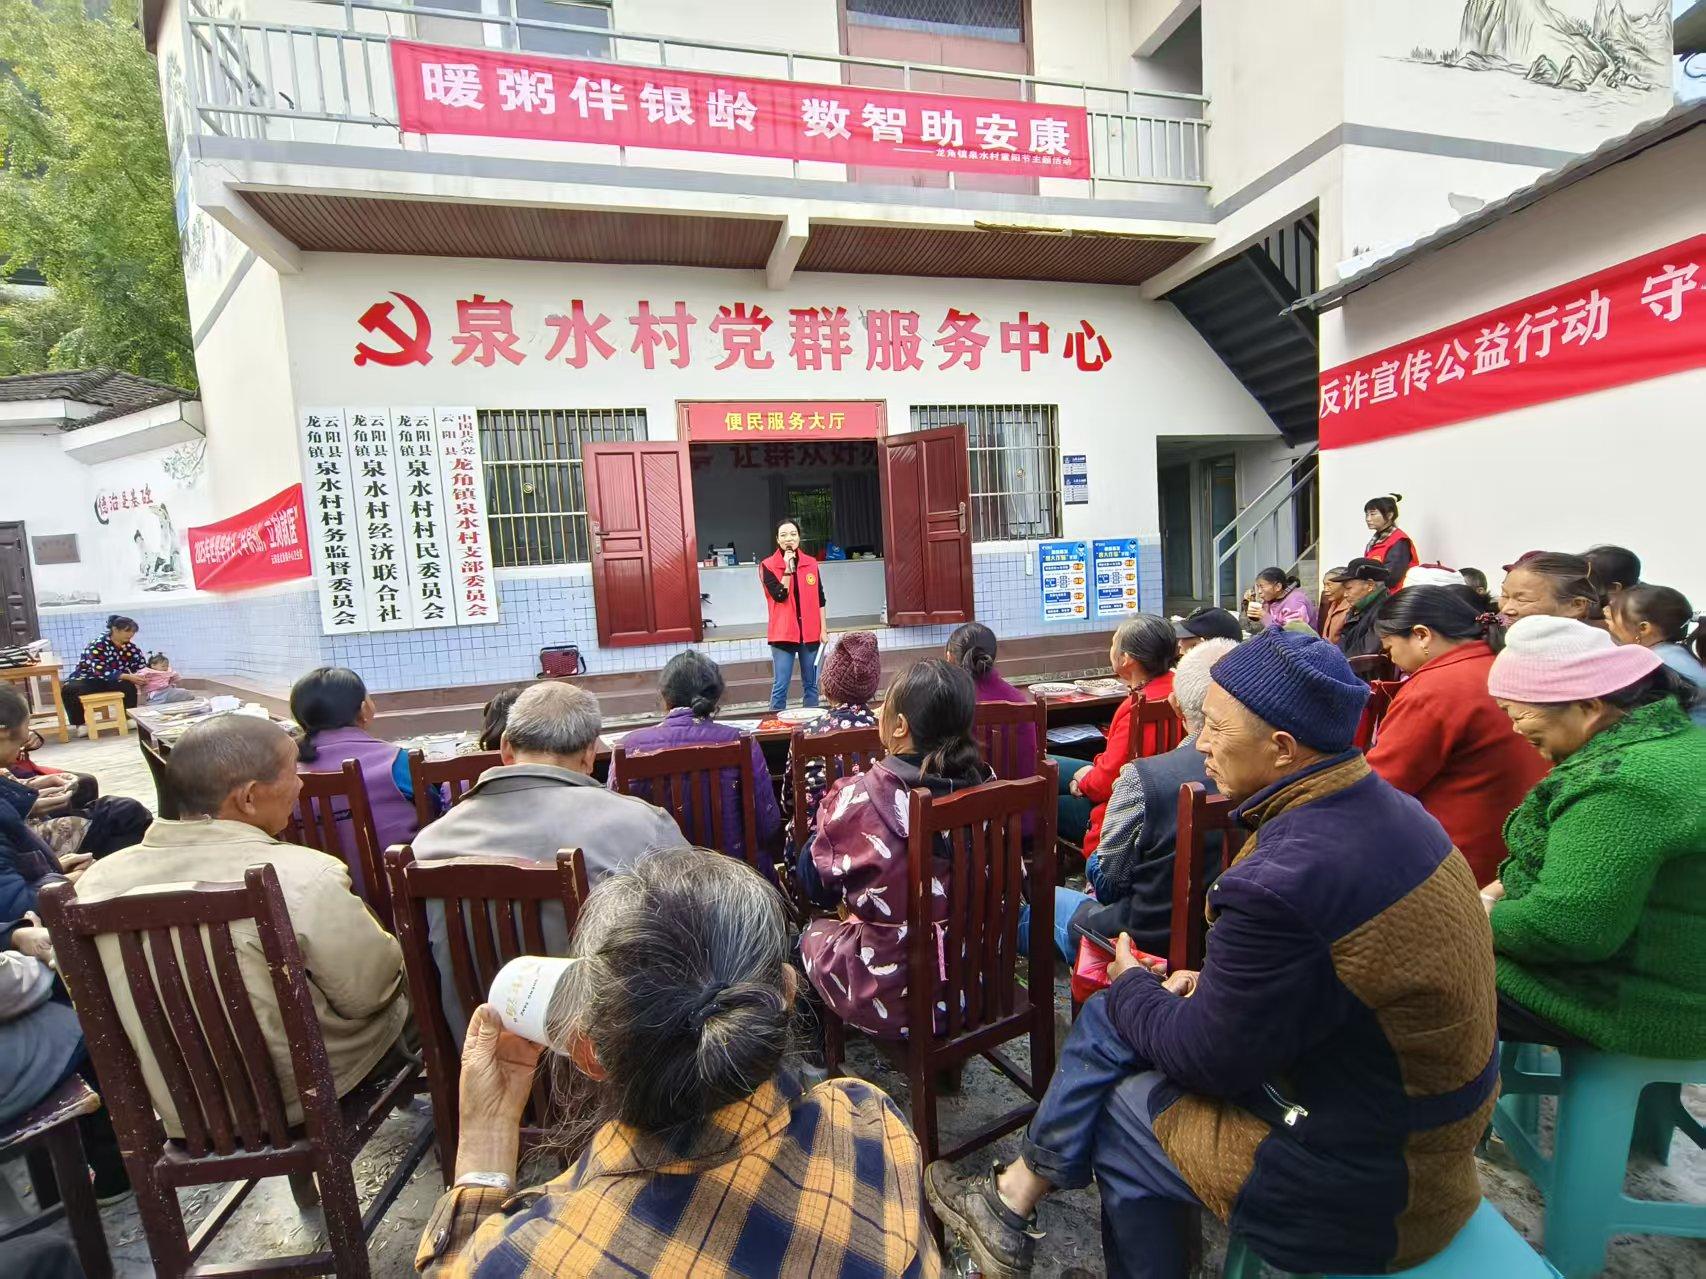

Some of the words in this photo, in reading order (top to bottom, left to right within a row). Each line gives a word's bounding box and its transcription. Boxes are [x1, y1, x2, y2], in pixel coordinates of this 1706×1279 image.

[420, 62, 758, 132] 暖粥伴银龄
[801, 97, 1071, 155] 数智助安康
[451, 293, 1113, 372] 泉水村党群服务中心
[1319, 288, 1611, 420] 反诈宣传公益行动
[724, 411, 846, 432] 便民服务大厅
[315, 461, 358, 626] 泉水村村务监督委员会
[361, 459, 403, 623] 泉水村经济联合社
[406, 459, 447, 621] 泉水村村民委员会
[450, 457, 489, 617] 龙角镇泉水村支部委员会
